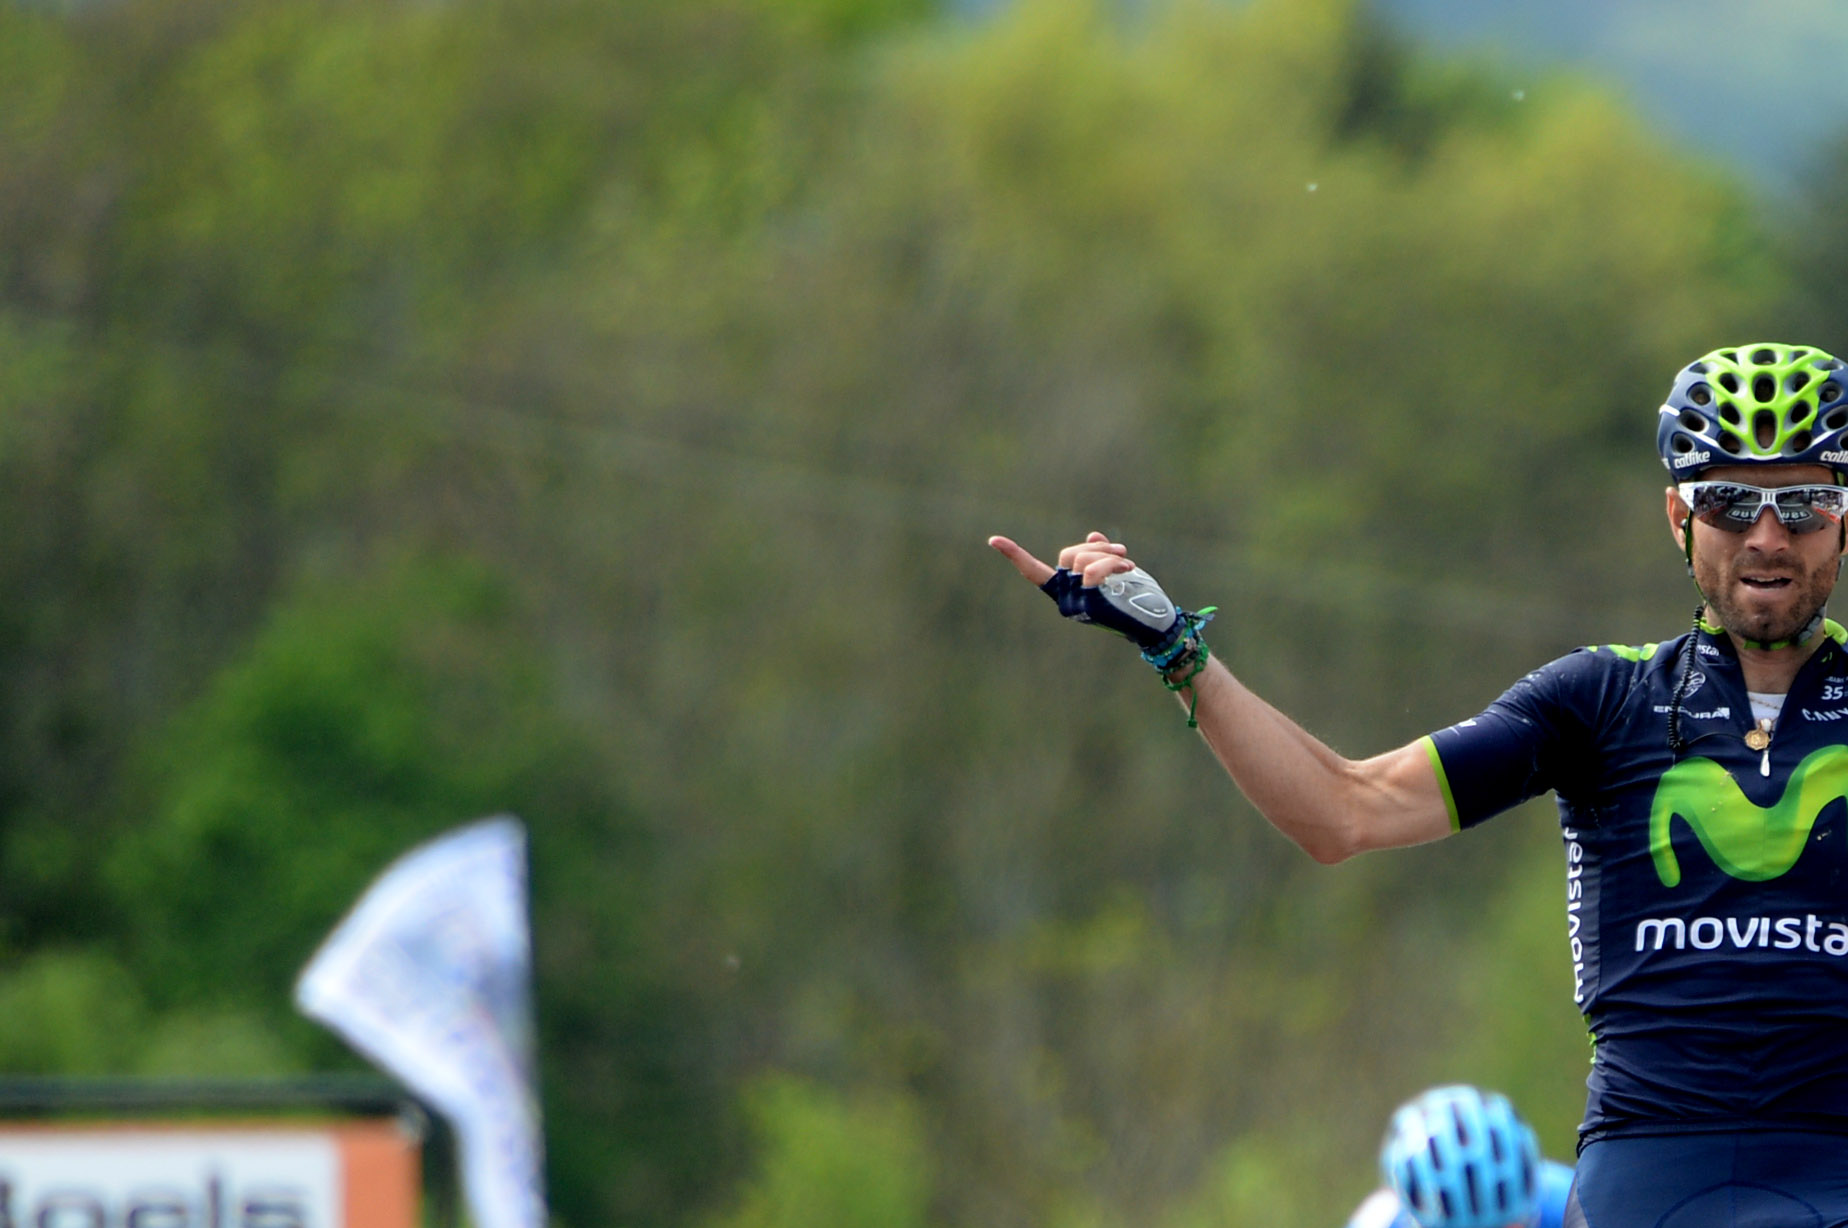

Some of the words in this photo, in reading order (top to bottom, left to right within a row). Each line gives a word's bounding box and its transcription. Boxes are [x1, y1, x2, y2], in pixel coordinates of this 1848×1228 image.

[1673, 451, 1712, 470] catlike
[1821, 685, 1844, 700] 35
[1563, 827, 1585, 1005] movistar
